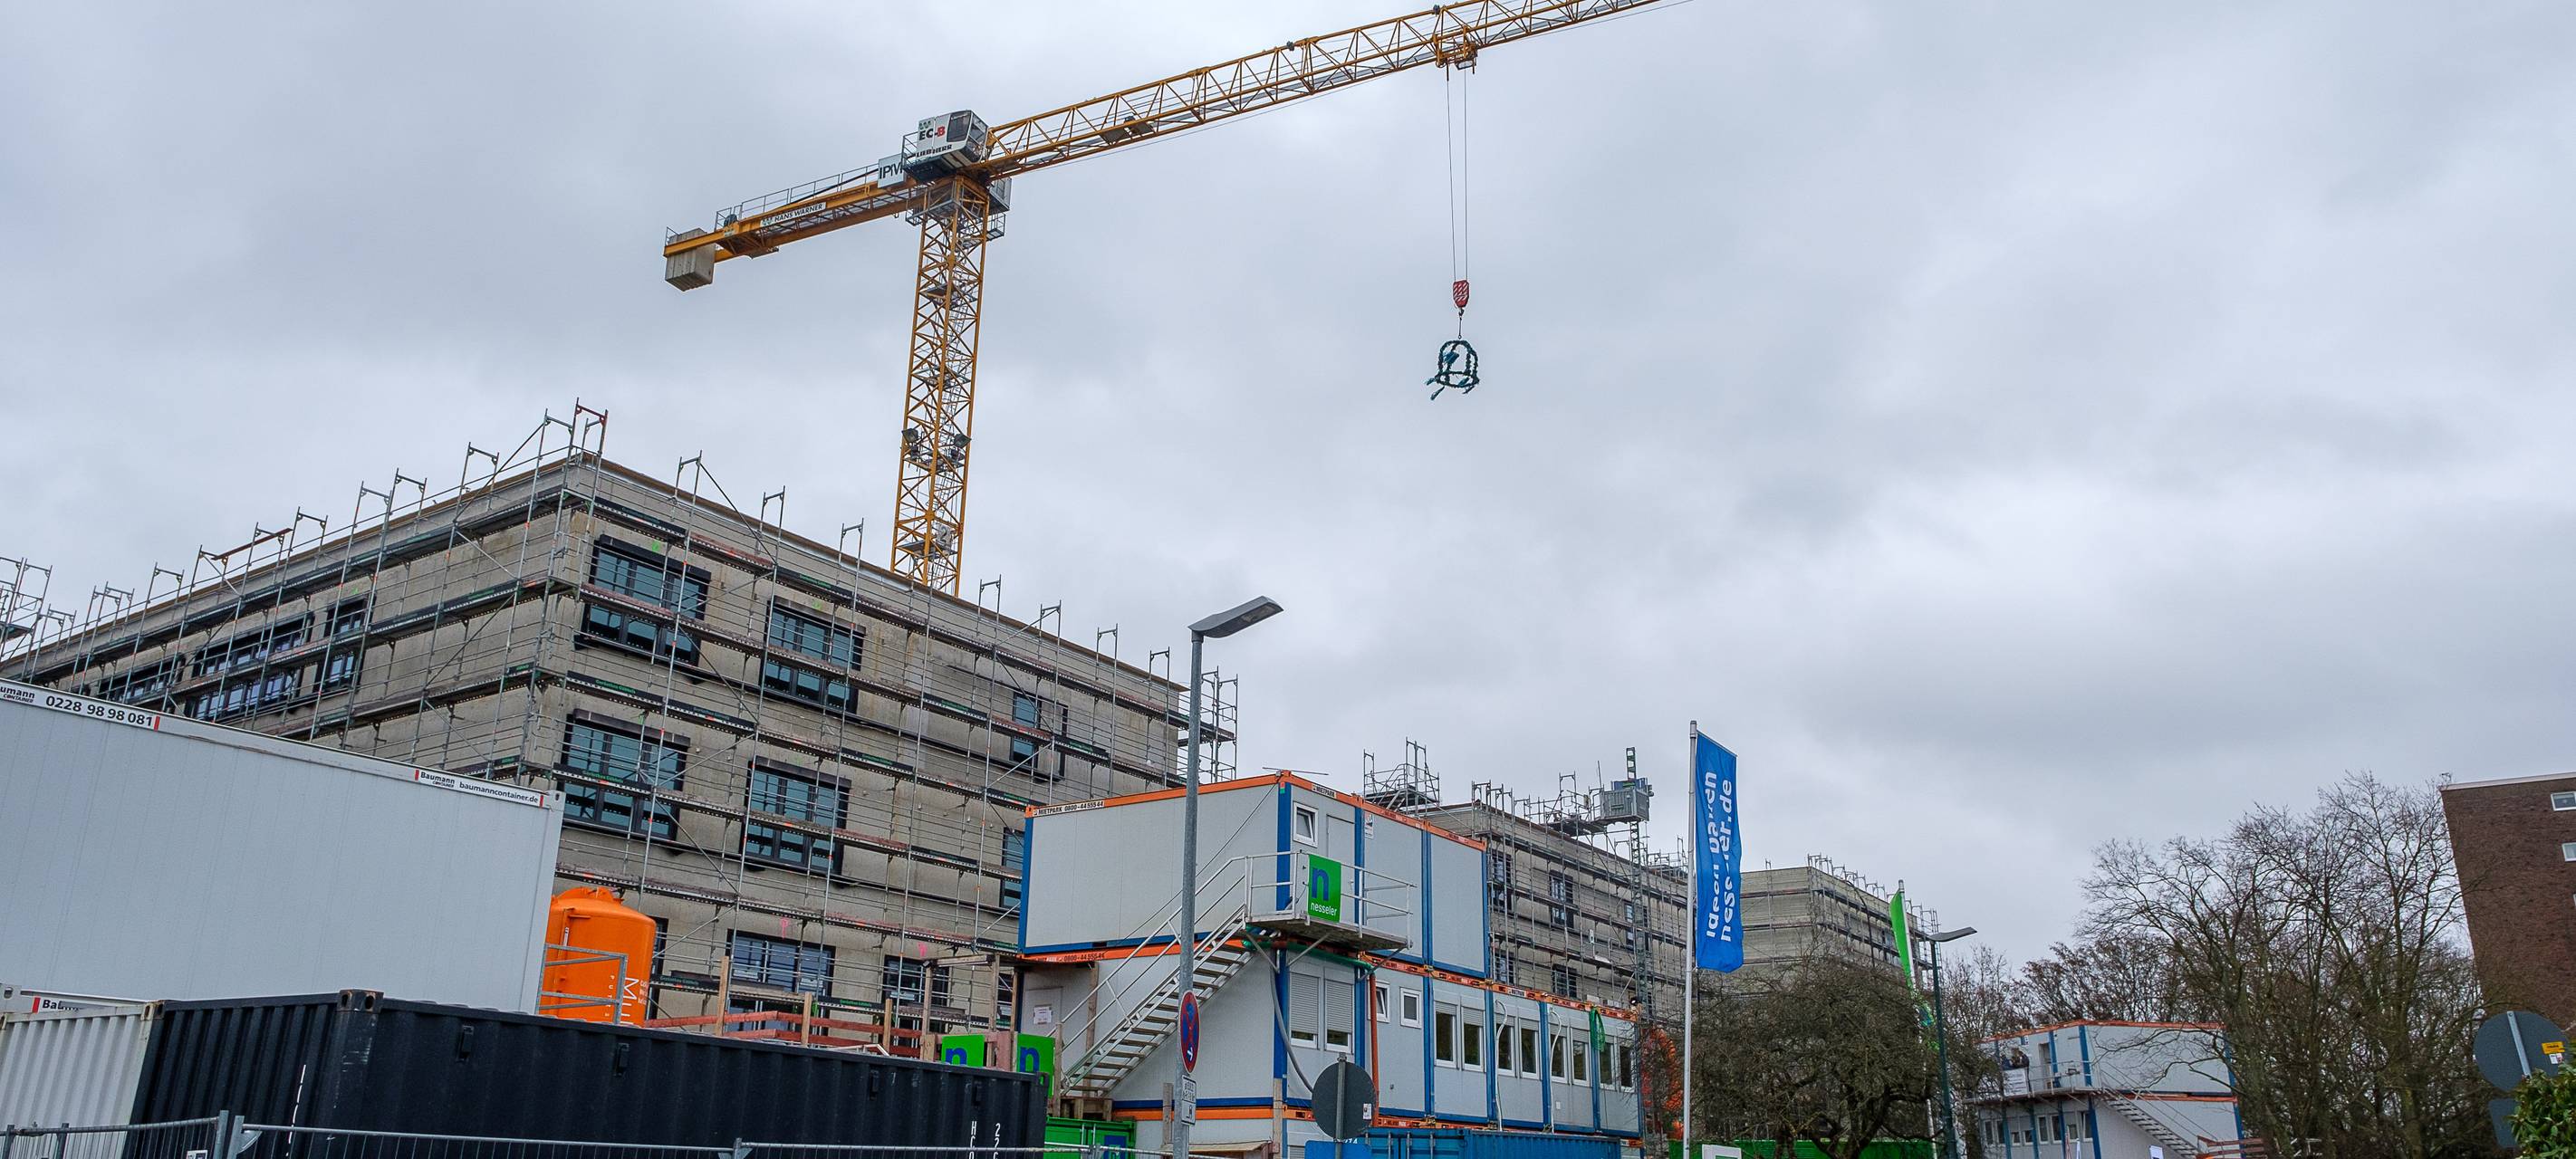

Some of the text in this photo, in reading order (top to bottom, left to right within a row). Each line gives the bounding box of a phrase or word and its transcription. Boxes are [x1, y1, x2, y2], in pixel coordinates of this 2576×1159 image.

[918, 126, 946, 140] EC-B
[916, 144, 953, 158] LIEBHERR
[774, 203, 823, 222] HANS WARNER
[0, 686, 153, 726] umann 0228 98 98 081
[4, 694, 34, 704] CONTAINER
[420, 771, 538, 804] Baumann baumanncontainer.de
[1038, 806, 1062, 816] MIETPARK
[1311, 902, 1338, 916] nesseler
